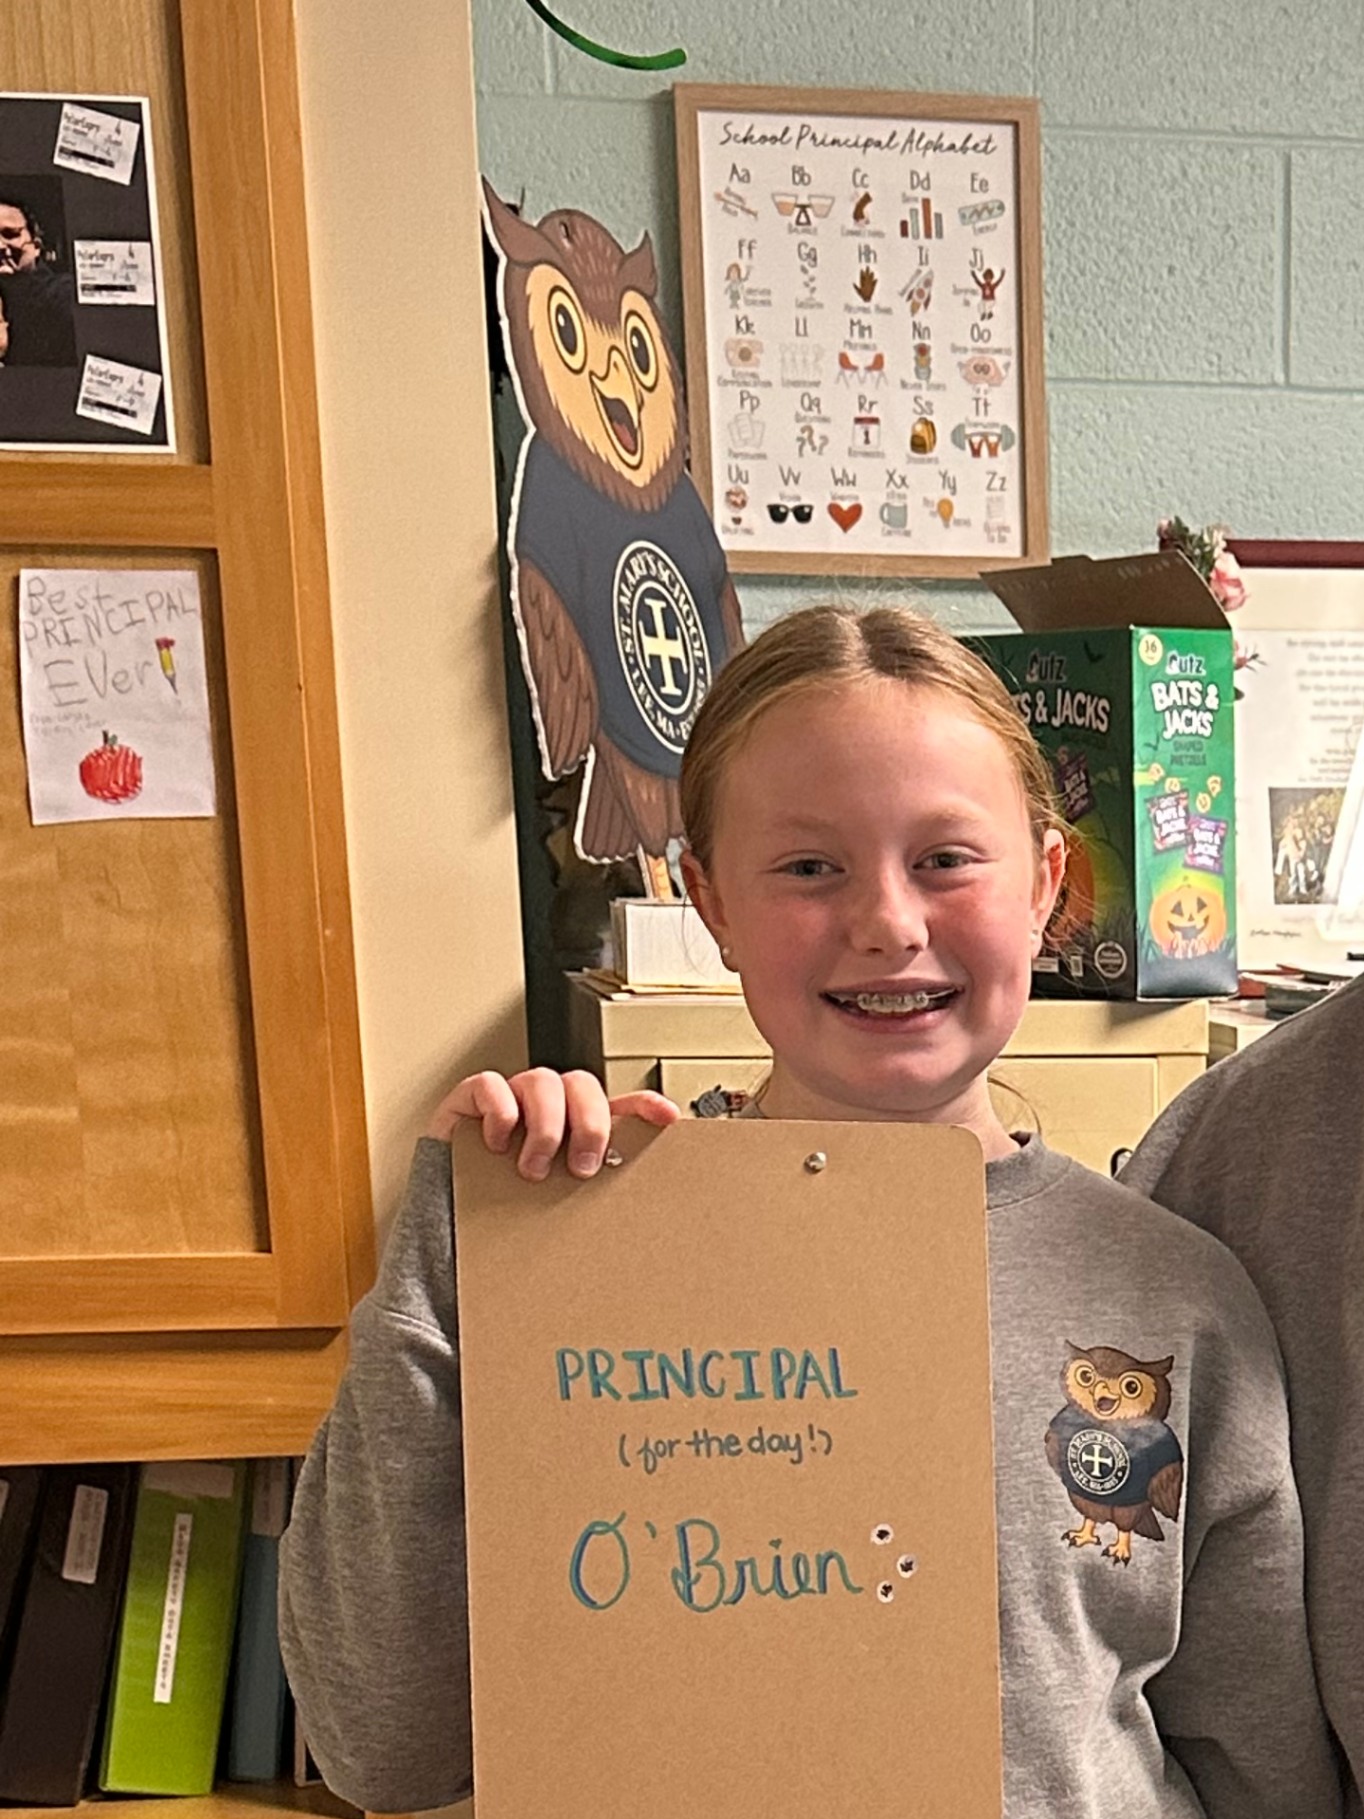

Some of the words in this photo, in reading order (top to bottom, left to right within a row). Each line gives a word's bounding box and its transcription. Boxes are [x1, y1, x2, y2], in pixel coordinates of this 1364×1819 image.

[719, 121, 793, 146] School
[795, 123, 899, 155] Principal
[900, 127, 998, 158] Alphabet
[729, 162, 751, 184] Aa
[791, 164, 811, 186] Bb
[852, 167, 870, 189] Cc
[909, 169, 931, 191] Dd
[970, 172, 989, 193] Ee
[738, 238, 757, 259] Ff
[797, 241, 818, 268] Gg
[857, 243, 878, 263] Hh
[918, 245, 929, 266] Ii
[968, 247, 984, 271] Jj
[735, 314, 755, 335] Kk
[849, 318, 872, 339] Mm
[912, 320, 931, 340] Nn
[970, 322, 991, 343] Oo
[740, 389, 760, 414] Pp
[800, 391, 821, 414] Qq
[857, 394, 878, 414] Rr
[912, 395, 934, 416] Ss
[972, 397, 991, 417] Tt
[728, 463, 749, 485] Uu
[778, 463, 802, 486] Vv
[830, 465, 857, 487] Ww
[885, 468, 909, 489] Xx
[938, 469, 957, 496] Yy
[986, 470, 1007, 491] Zz
[26, 576, 113, 616] Best
[21, 588, 197, 659] PRINCIPAL
[1034, 690, 1049, 724] &
[1051, 687, 1111, 733] JACKS
[1151, 679, 1202, 712] BATS
[1204, 683, 1220, 711] &
[1162, 708, 1215, 741] JACKS
[555, 1347, 859, 1402] PRINCIPAL
[618, 1432, 681, 1476] (for
[684, 1427, 743, 1459] the
[747, 1422, 833, 1465] day!)
[569, 1510, 865, 1614] O'Brien
